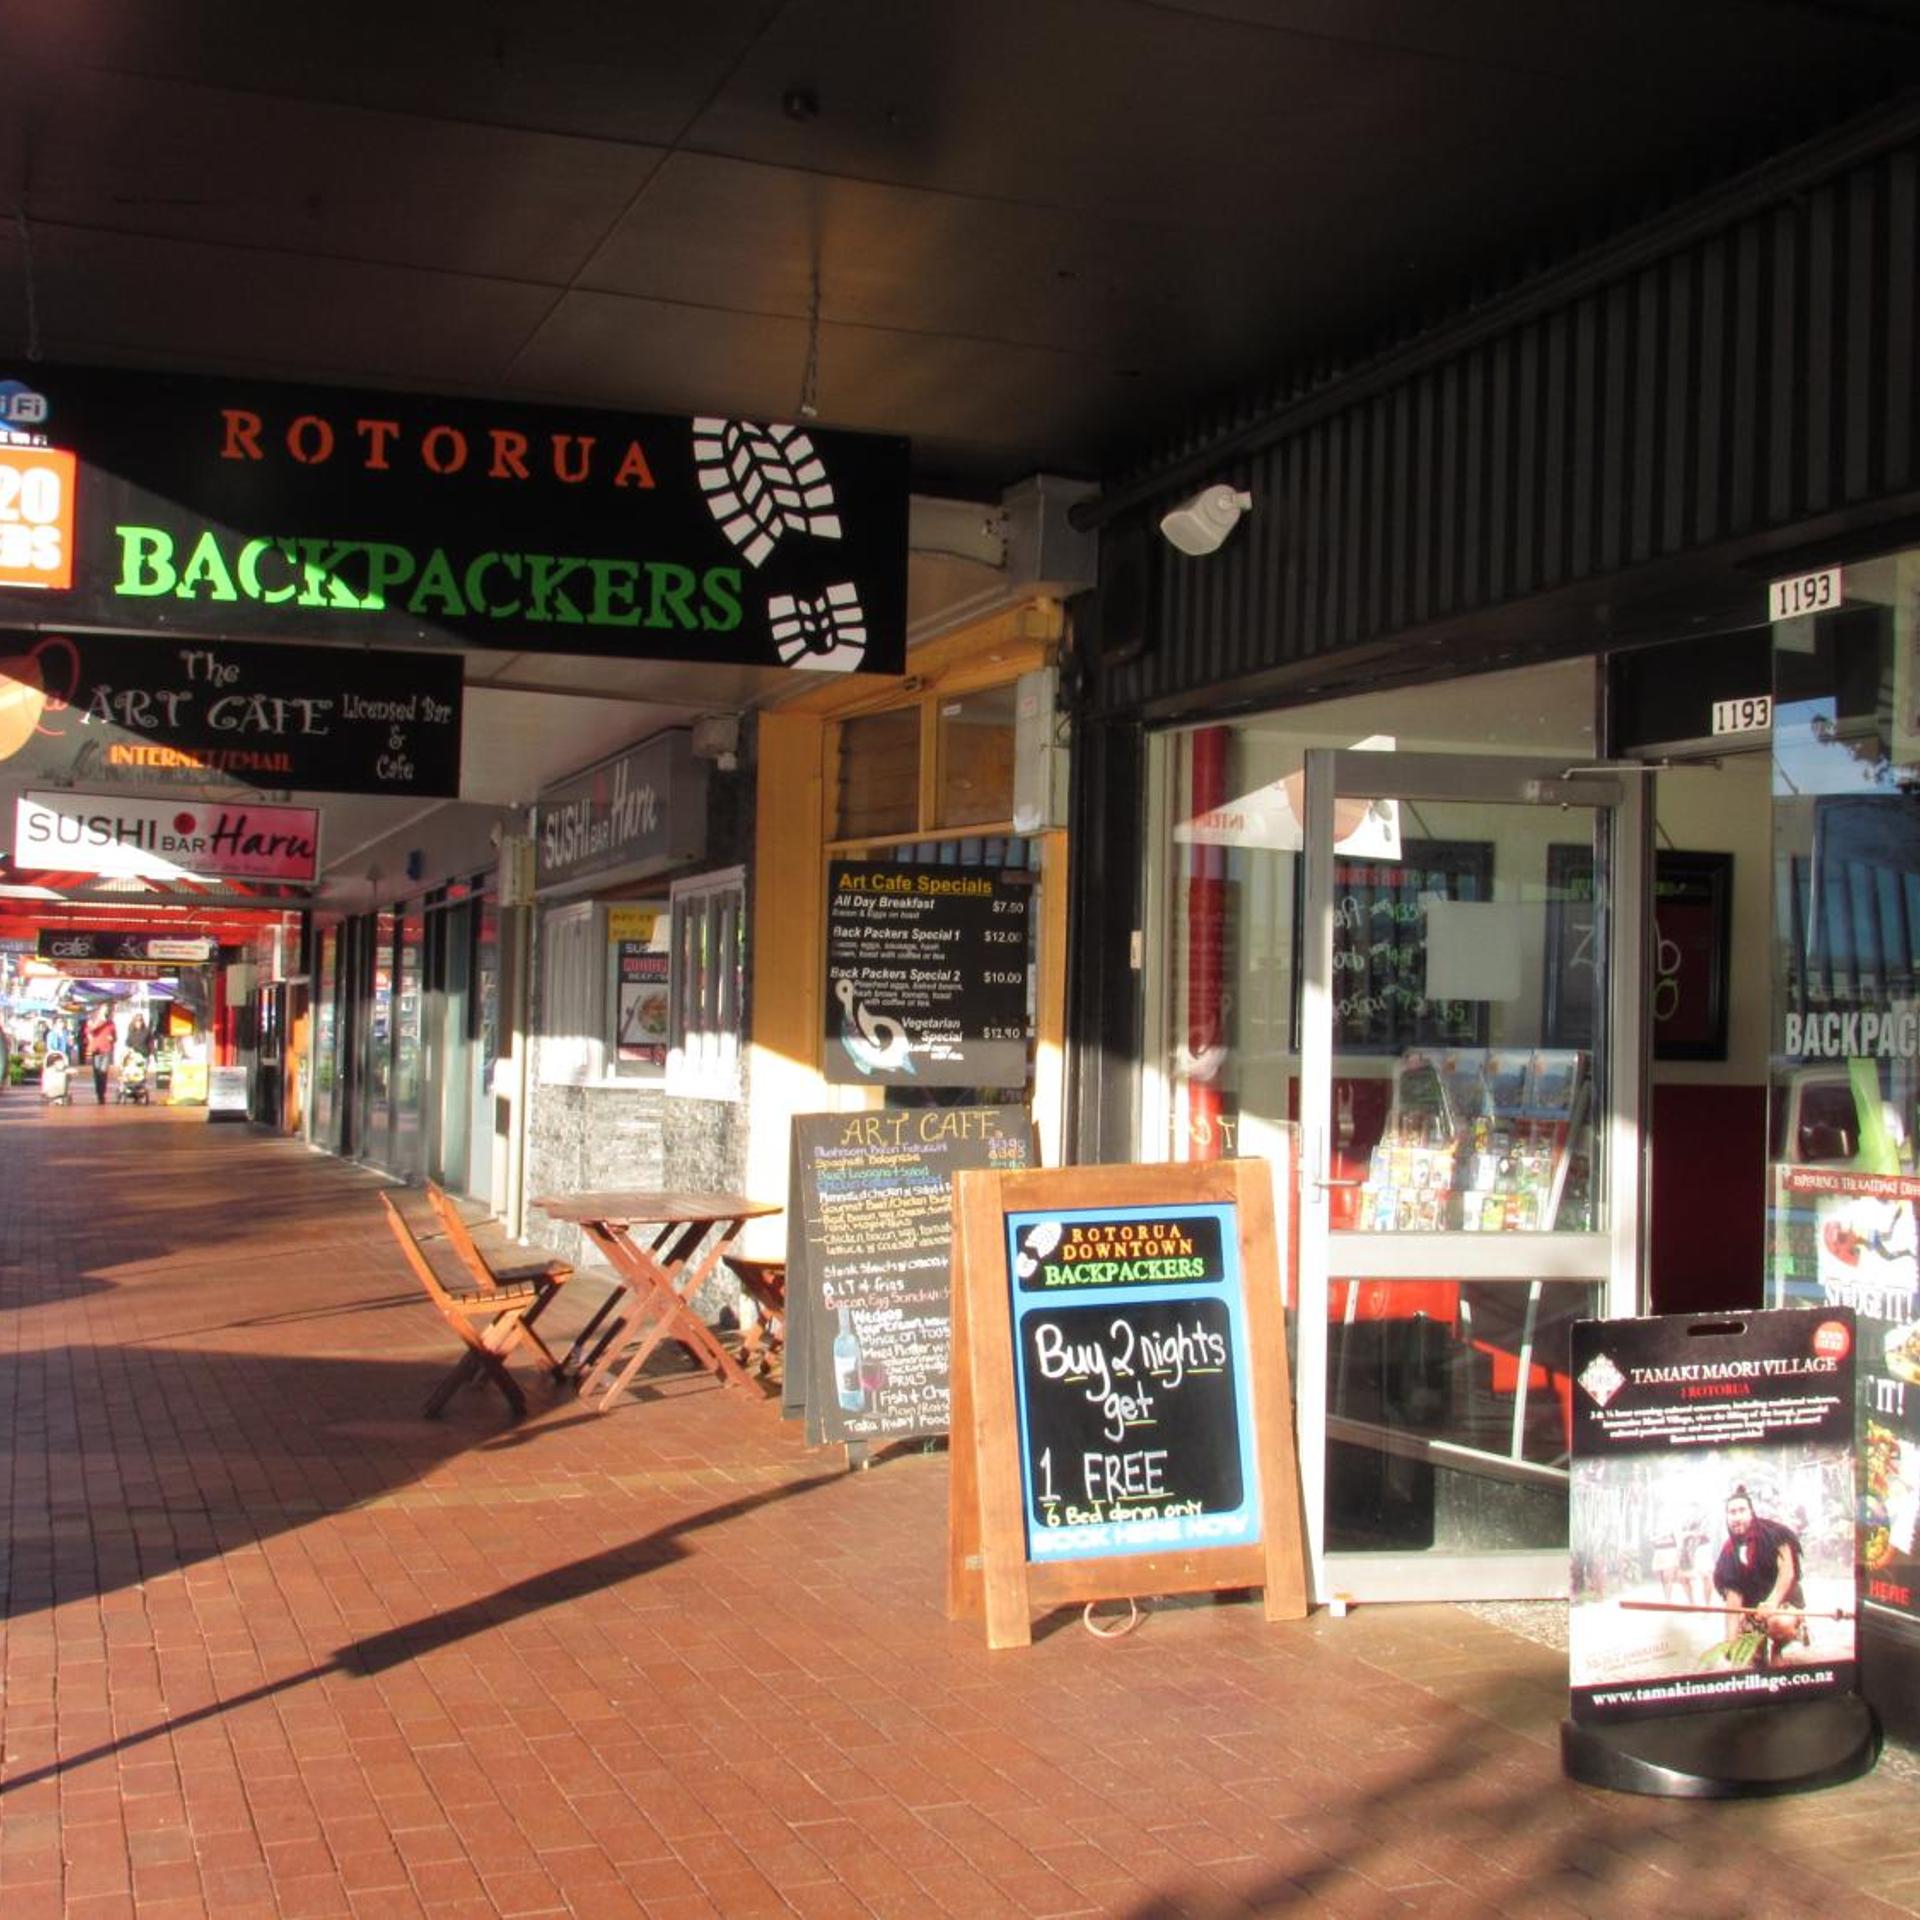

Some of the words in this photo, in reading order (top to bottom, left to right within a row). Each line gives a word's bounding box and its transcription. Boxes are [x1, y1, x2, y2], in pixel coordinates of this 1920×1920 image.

[219, 409, 656, 489] ROTORUA
[114, 525, 744, 632] BACKPACKERS
[1779, 574, 1832, 616] 1193
[180, 650, 241, 688] The
[79, 684, 193, 729] ART
[207, 693, 334, 735] CAFE
[342, 693, 418, 721] Licensed
[421, 696, 452, 723] Bar
[1716, 699, 1770, 733] 1193
[109, 744, 294, 773] INTERNET/EMAIL
[546, 797, 590, 869] SUSHI
[610, 758, 658, 848] Haru
[27, 811, 157, 850] SUSHI
[161, 835, 208, 854] BAR
[210, 812, 314, 859] Haru
[840, 873, 866, 889] Art
[871, 873, 912, 890] Cafe
[917, 875, 992, 895] Specials
[834, 894, 851, 907] All
[853, 895, 877, 909] Day
[879, 896, 935, 909] Breakfast
[992, 901, 1024, 913] $7.50
[833, 925, 861, 938] Back
[864, 926, 909, 939] Packers
[912, 927, 953, 941] Special
[954, 929, 961, 941] 1
[983, 931, 1022, 943] $12.00
[829, 966, 859, 979] Back
[862, 966, 907, 980] Packers
[910, 968, 952, 982] Special
[953, 970, 961, 981] 2
[983, 971, 1022, 983] $10.00
[901, 1017, 961, 1031] Vegetarian
[920, 1030, 963, 1044] Special
[1785, 1011, 1920, 1057] BACKPAC
[841, 1112, 910, 1146] ART
[920, 1108, 1000, 1142] CAFE
[1071, 1224, 1182, 1243] ROTORUA
[1061, 1239, 1194, 1261] DOWNTOWN
[1044, 1257, 1206, 1286] BACKPACKERS
[1034, 1322, 1111, 1401] Buy
[1109, 1318, 1135, 1378] 2
[1140, 1320, 1227, 1389] nights
[1630, 1364, 1701, 1385] TAMAKI
[1702, 1361, 1760, 1380] MAORI
[1763, 1356, 1838, 1376] VILLAGE
[1103, 1380, 1155, 1443] get
[1876, 1378, 1904, 1417] IT!
[1038, 1446, 1062, 1502] 1
[1082, 1449, 1170, 1503] FREE
[1046, 1504, 1062, 1528] 6
[1064, 1502, 1104, 1526] Bed
[1108, 1502, 1159, 1521] dorm
[1164, 1499, 1203, 1518] only
[1591, 1670, 1835, 1706] www.tamakimaorivillage.co.nz
